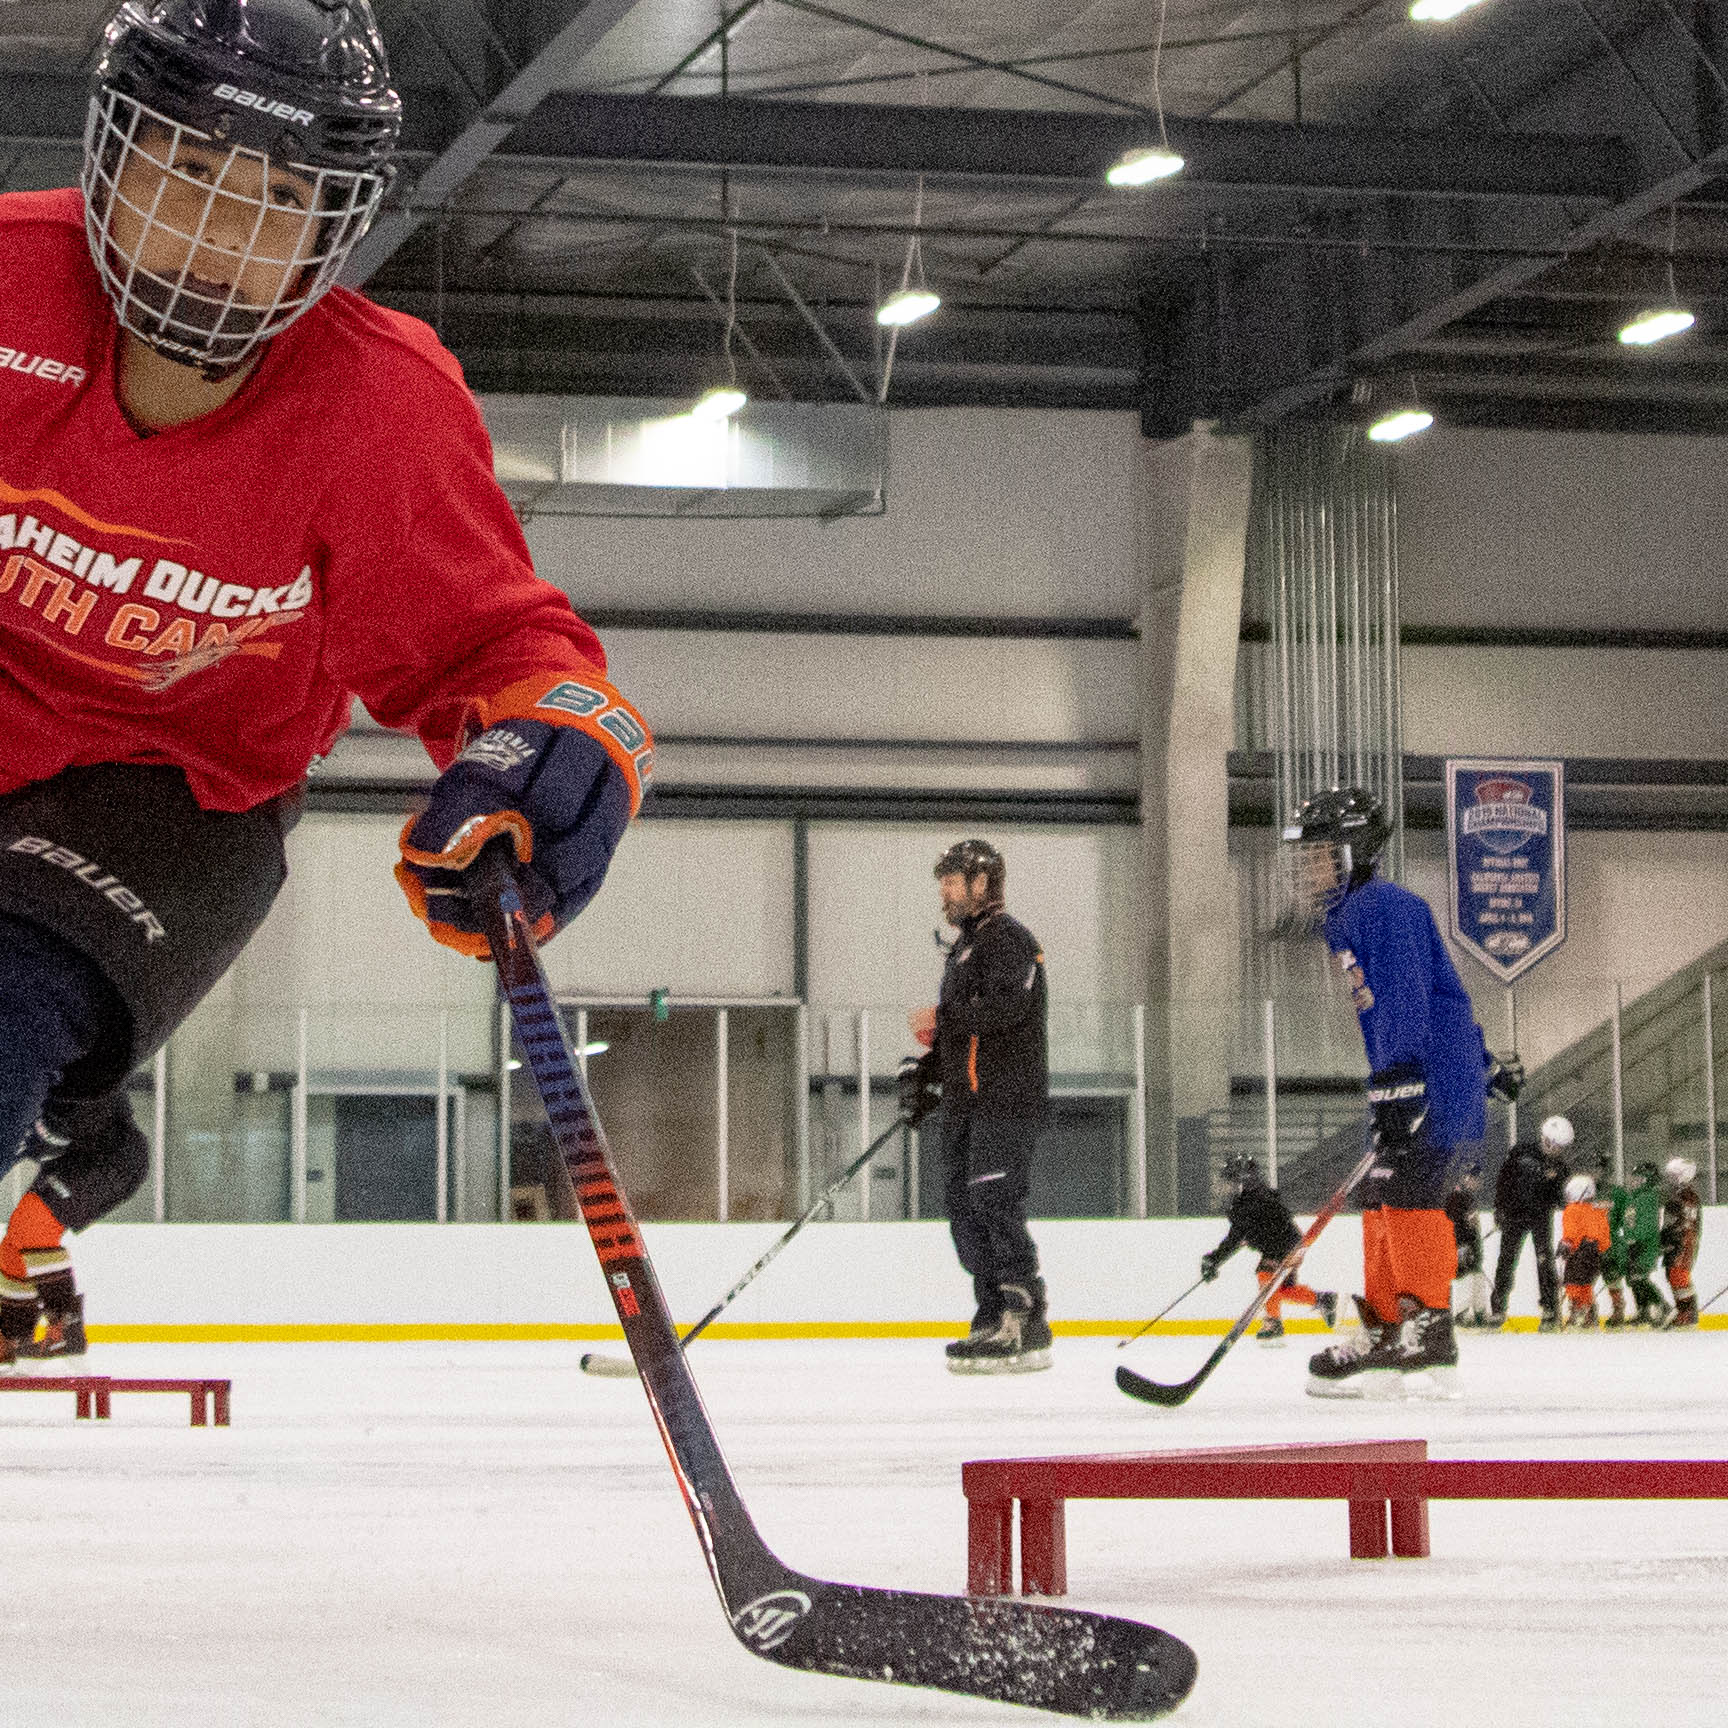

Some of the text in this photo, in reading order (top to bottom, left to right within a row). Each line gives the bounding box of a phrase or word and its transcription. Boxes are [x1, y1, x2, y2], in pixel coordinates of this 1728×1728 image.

[213, 84, 314, 127] BAUER
[143, 559, 313, 618] DUCKS
[9, 835, 167, 943] BAUER
